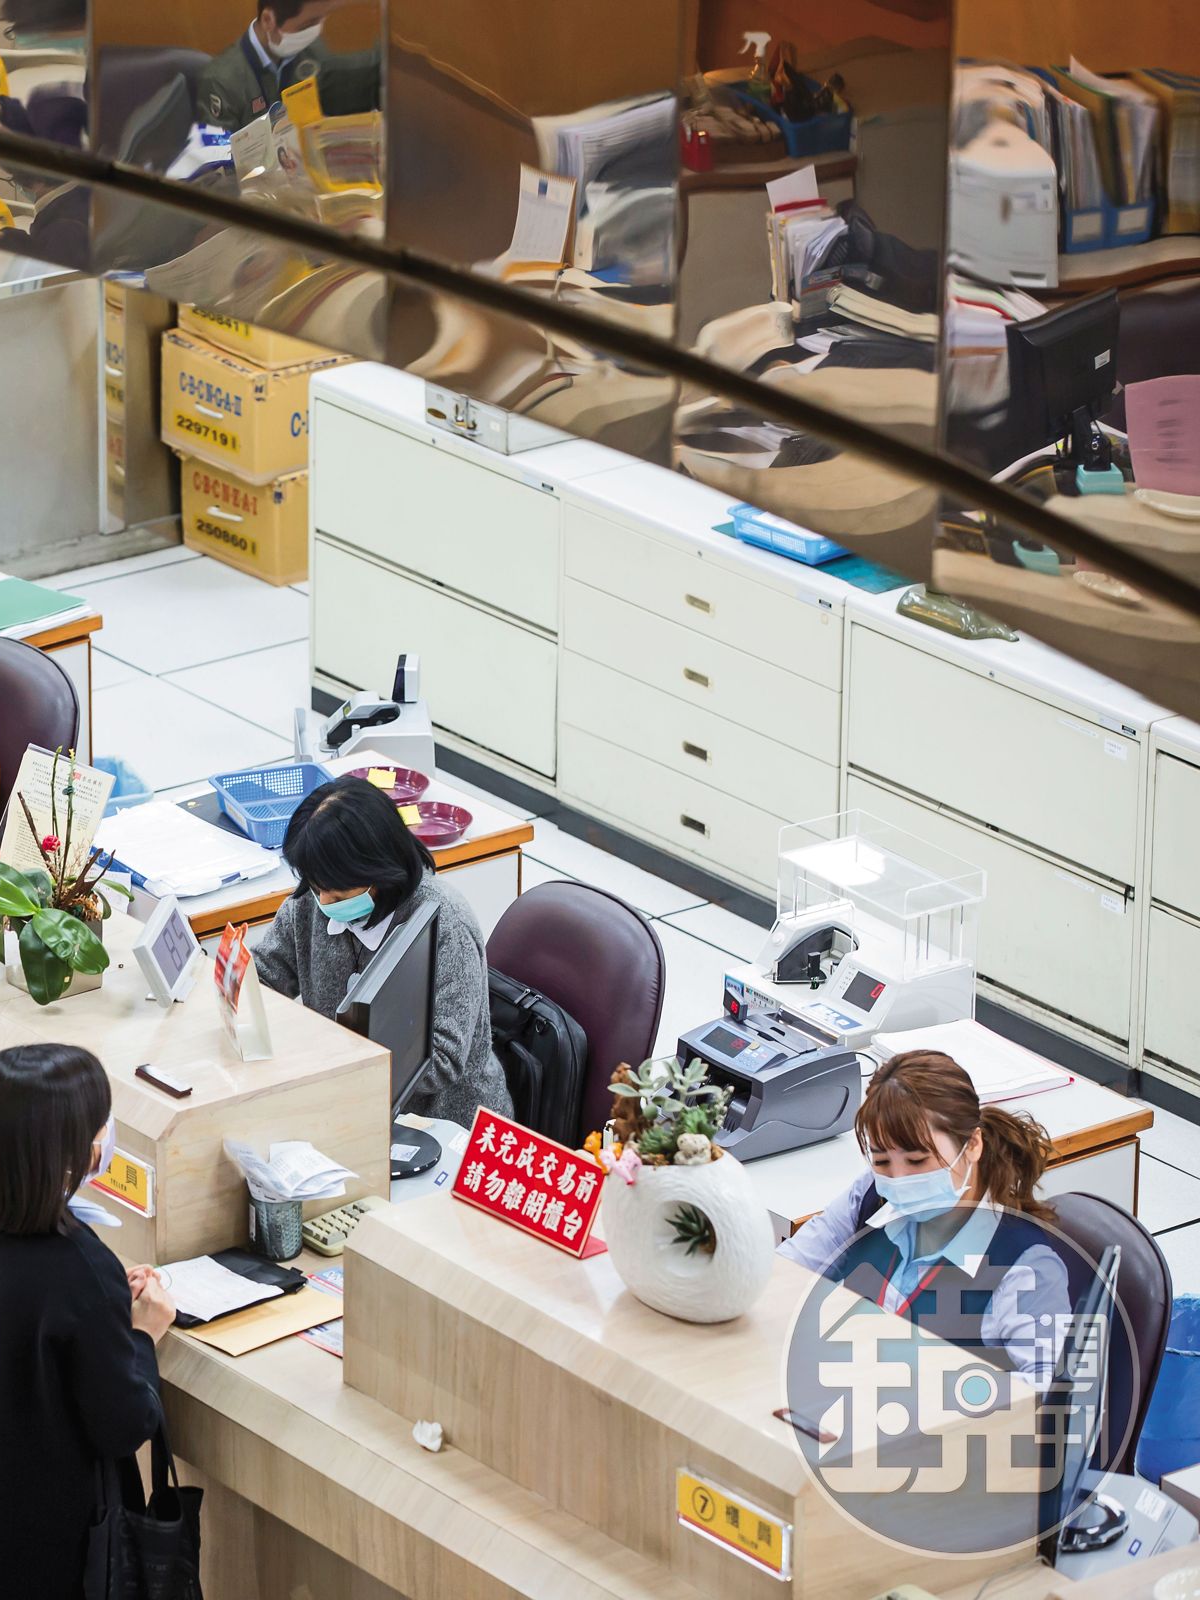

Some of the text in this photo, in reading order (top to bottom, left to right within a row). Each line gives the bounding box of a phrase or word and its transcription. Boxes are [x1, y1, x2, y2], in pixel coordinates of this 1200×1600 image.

[463, 1160, 583, 1241] 請勿離開櫃台
[475, 1122, 598, 1204] 未完成交易前
